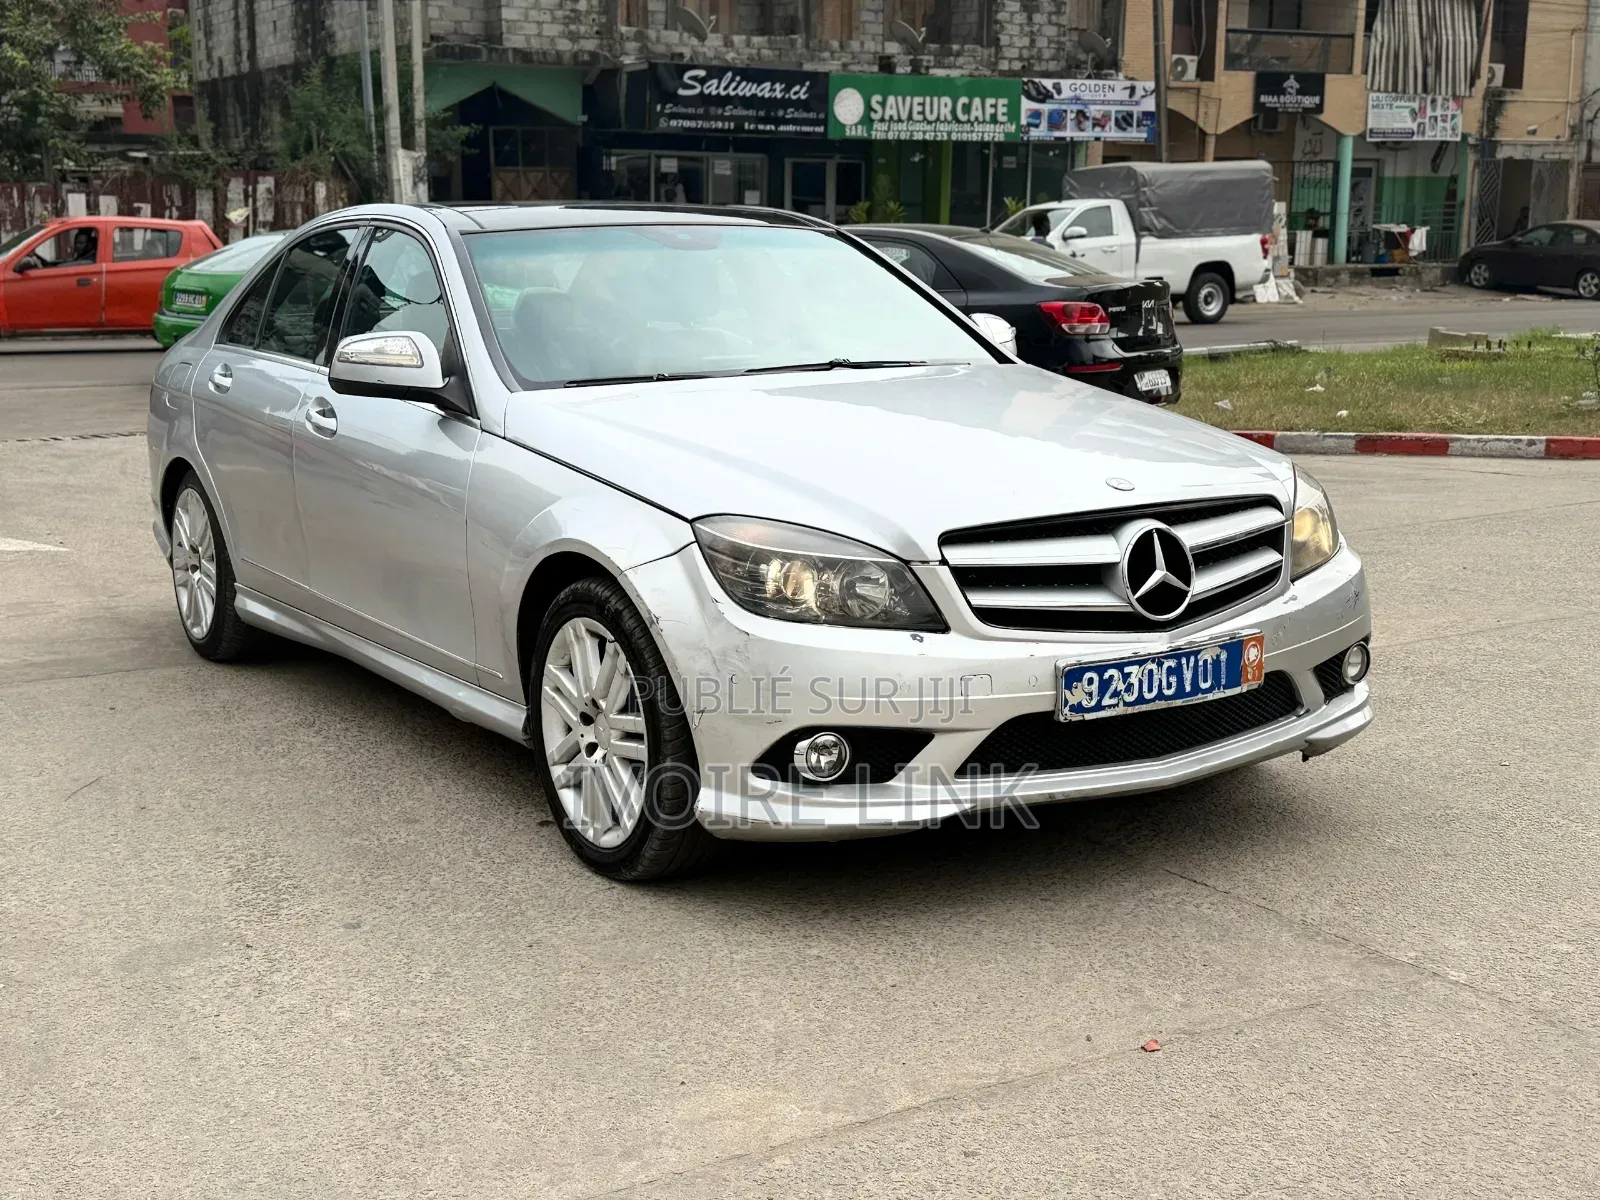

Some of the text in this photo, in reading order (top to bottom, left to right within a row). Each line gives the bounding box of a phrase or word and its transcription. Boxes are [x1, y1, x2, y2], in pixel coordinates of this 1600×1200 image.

[677, 69, 811, 100] Saliwax.ci
[1069, 83, 1116, 93] GOLDEN
[1279, 95, 1320, 104] BOUTIQUE
[870, 94, 1008, 123] SAVEUR CAFE
[845, 126, 868, 137] SARL
